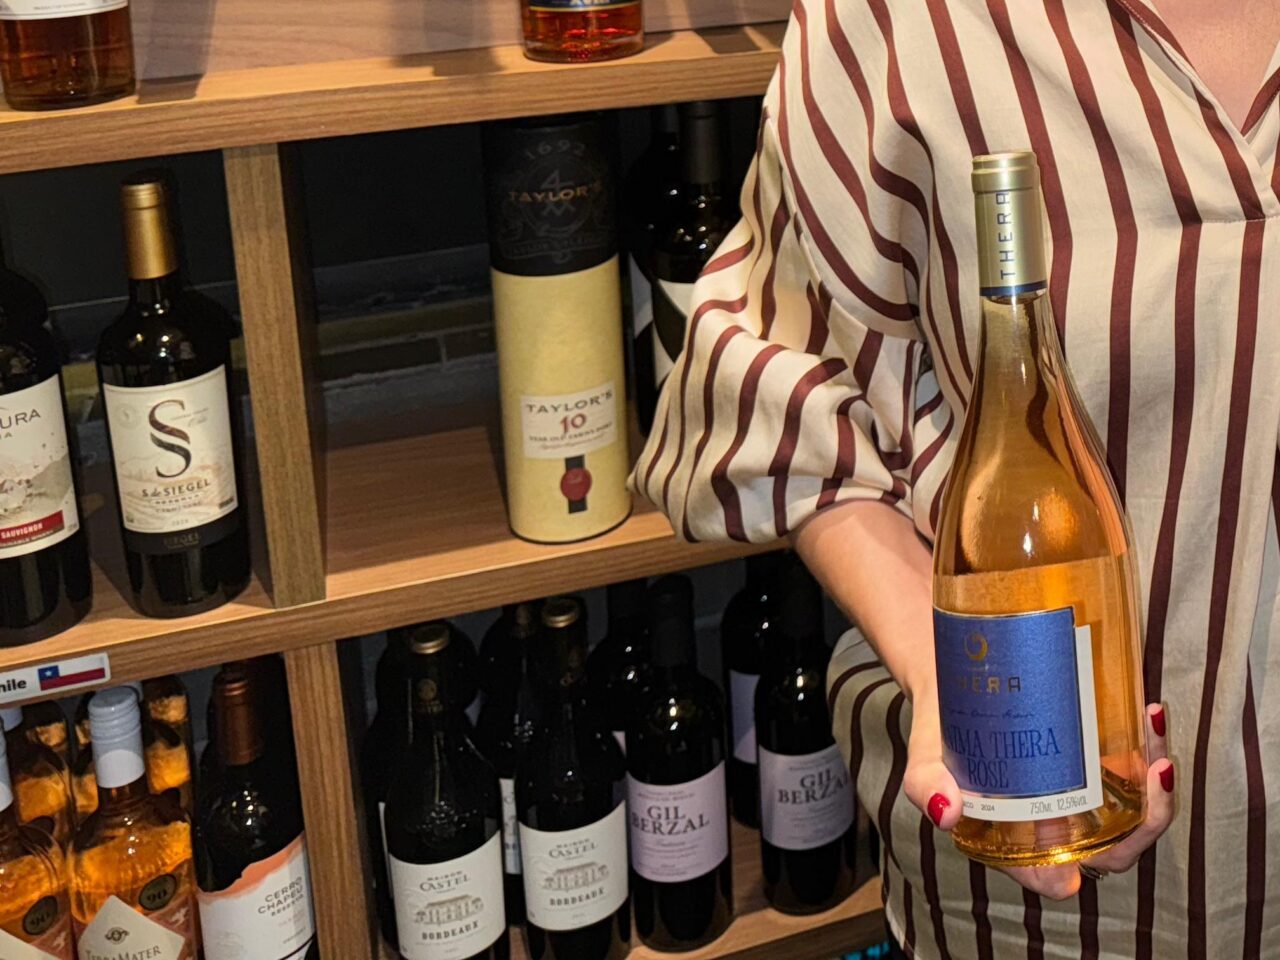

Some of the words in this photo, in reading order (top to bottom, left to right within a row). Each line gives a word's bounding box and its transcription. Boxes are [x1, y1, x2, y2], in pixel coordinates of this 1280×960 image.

[995, 190, 1017, 281] THERA
[525, 389, 613, 414] TAYLOR'S
[560, 413, 587, 434] 10
[163, 478, 212, 497] SIEGEL
[1, 522, 44, 539] SAUVIGNON
[988, 727, 1062, 760] THERA
[800, 768, 836, 789] GIL
[646, 805, 687, 821] GIL
[631, 812, 711, 836] BERZAL
[548, 843, 599, 859] CASTEL
[264, 876, 303, 903] CERRO
[419, 875, 471, 892] CASTEL
[549, 887, 605, 907] BORDEAUX
[421, 920, 480, 940] BORDEAUX
